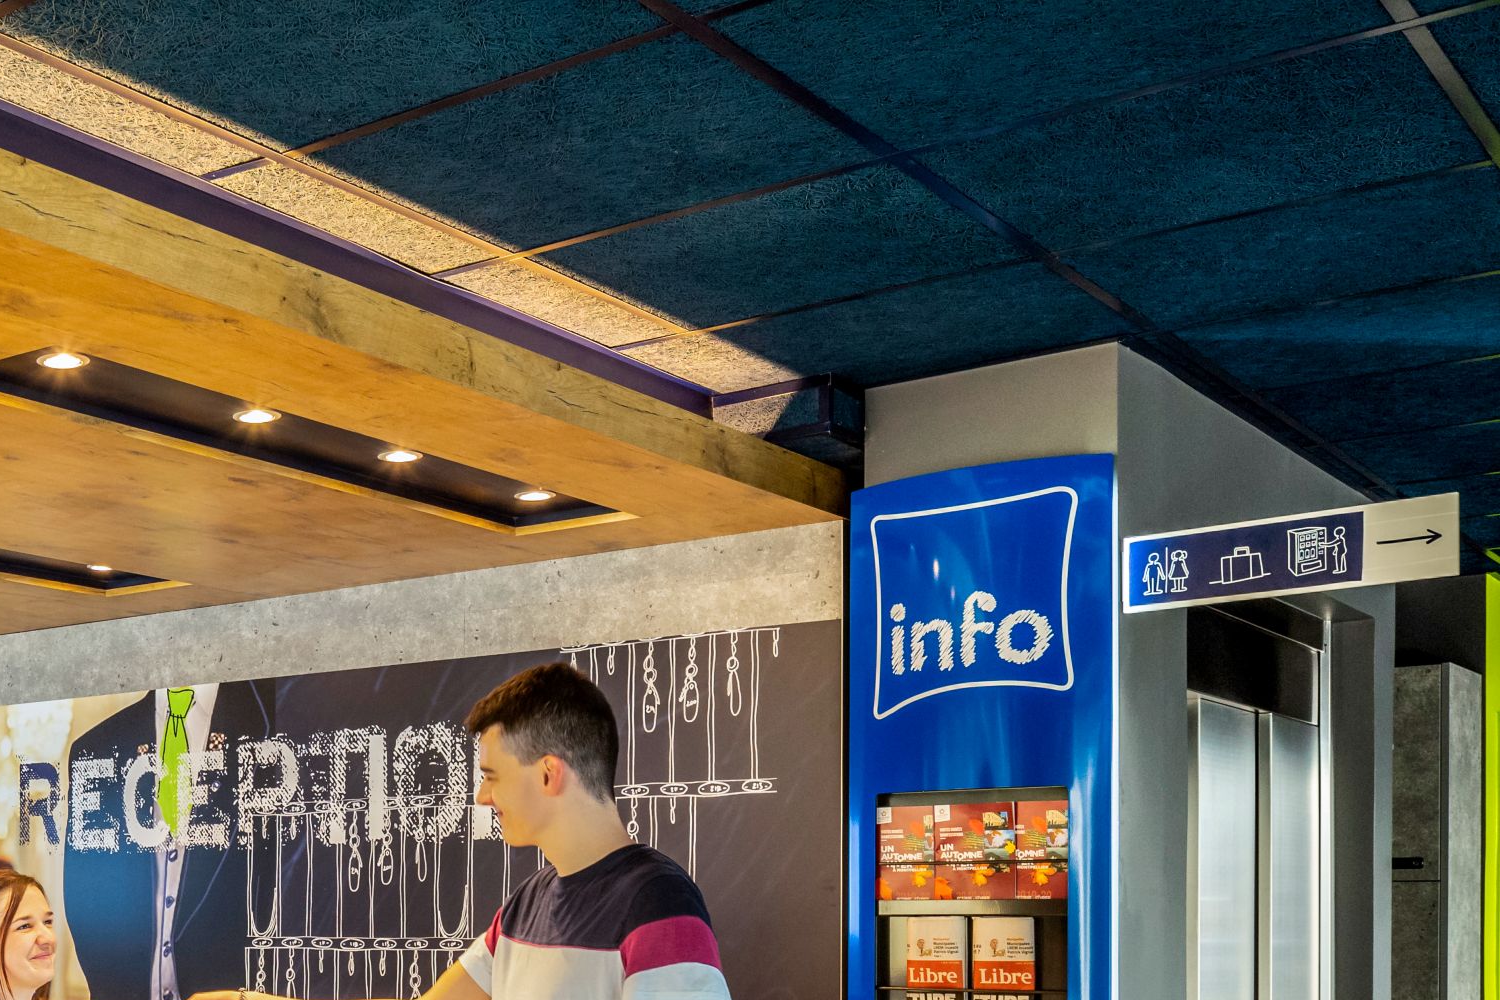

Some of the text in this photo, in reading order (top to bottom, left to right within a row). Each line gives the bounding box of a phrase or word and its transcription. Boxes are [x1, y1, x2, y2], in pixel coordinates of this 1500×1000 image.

[890, 590, 1055, 676] info
[881, 845, 895, 853] UN
[940, 843, 954, 851] UN
[881, 852, 923, 862] AUTOMNE
[940, 851, 984, 860] AUTOMNE
[908, 967, 958, 983] Libre
[979, 968, 1033, 984] Libre
